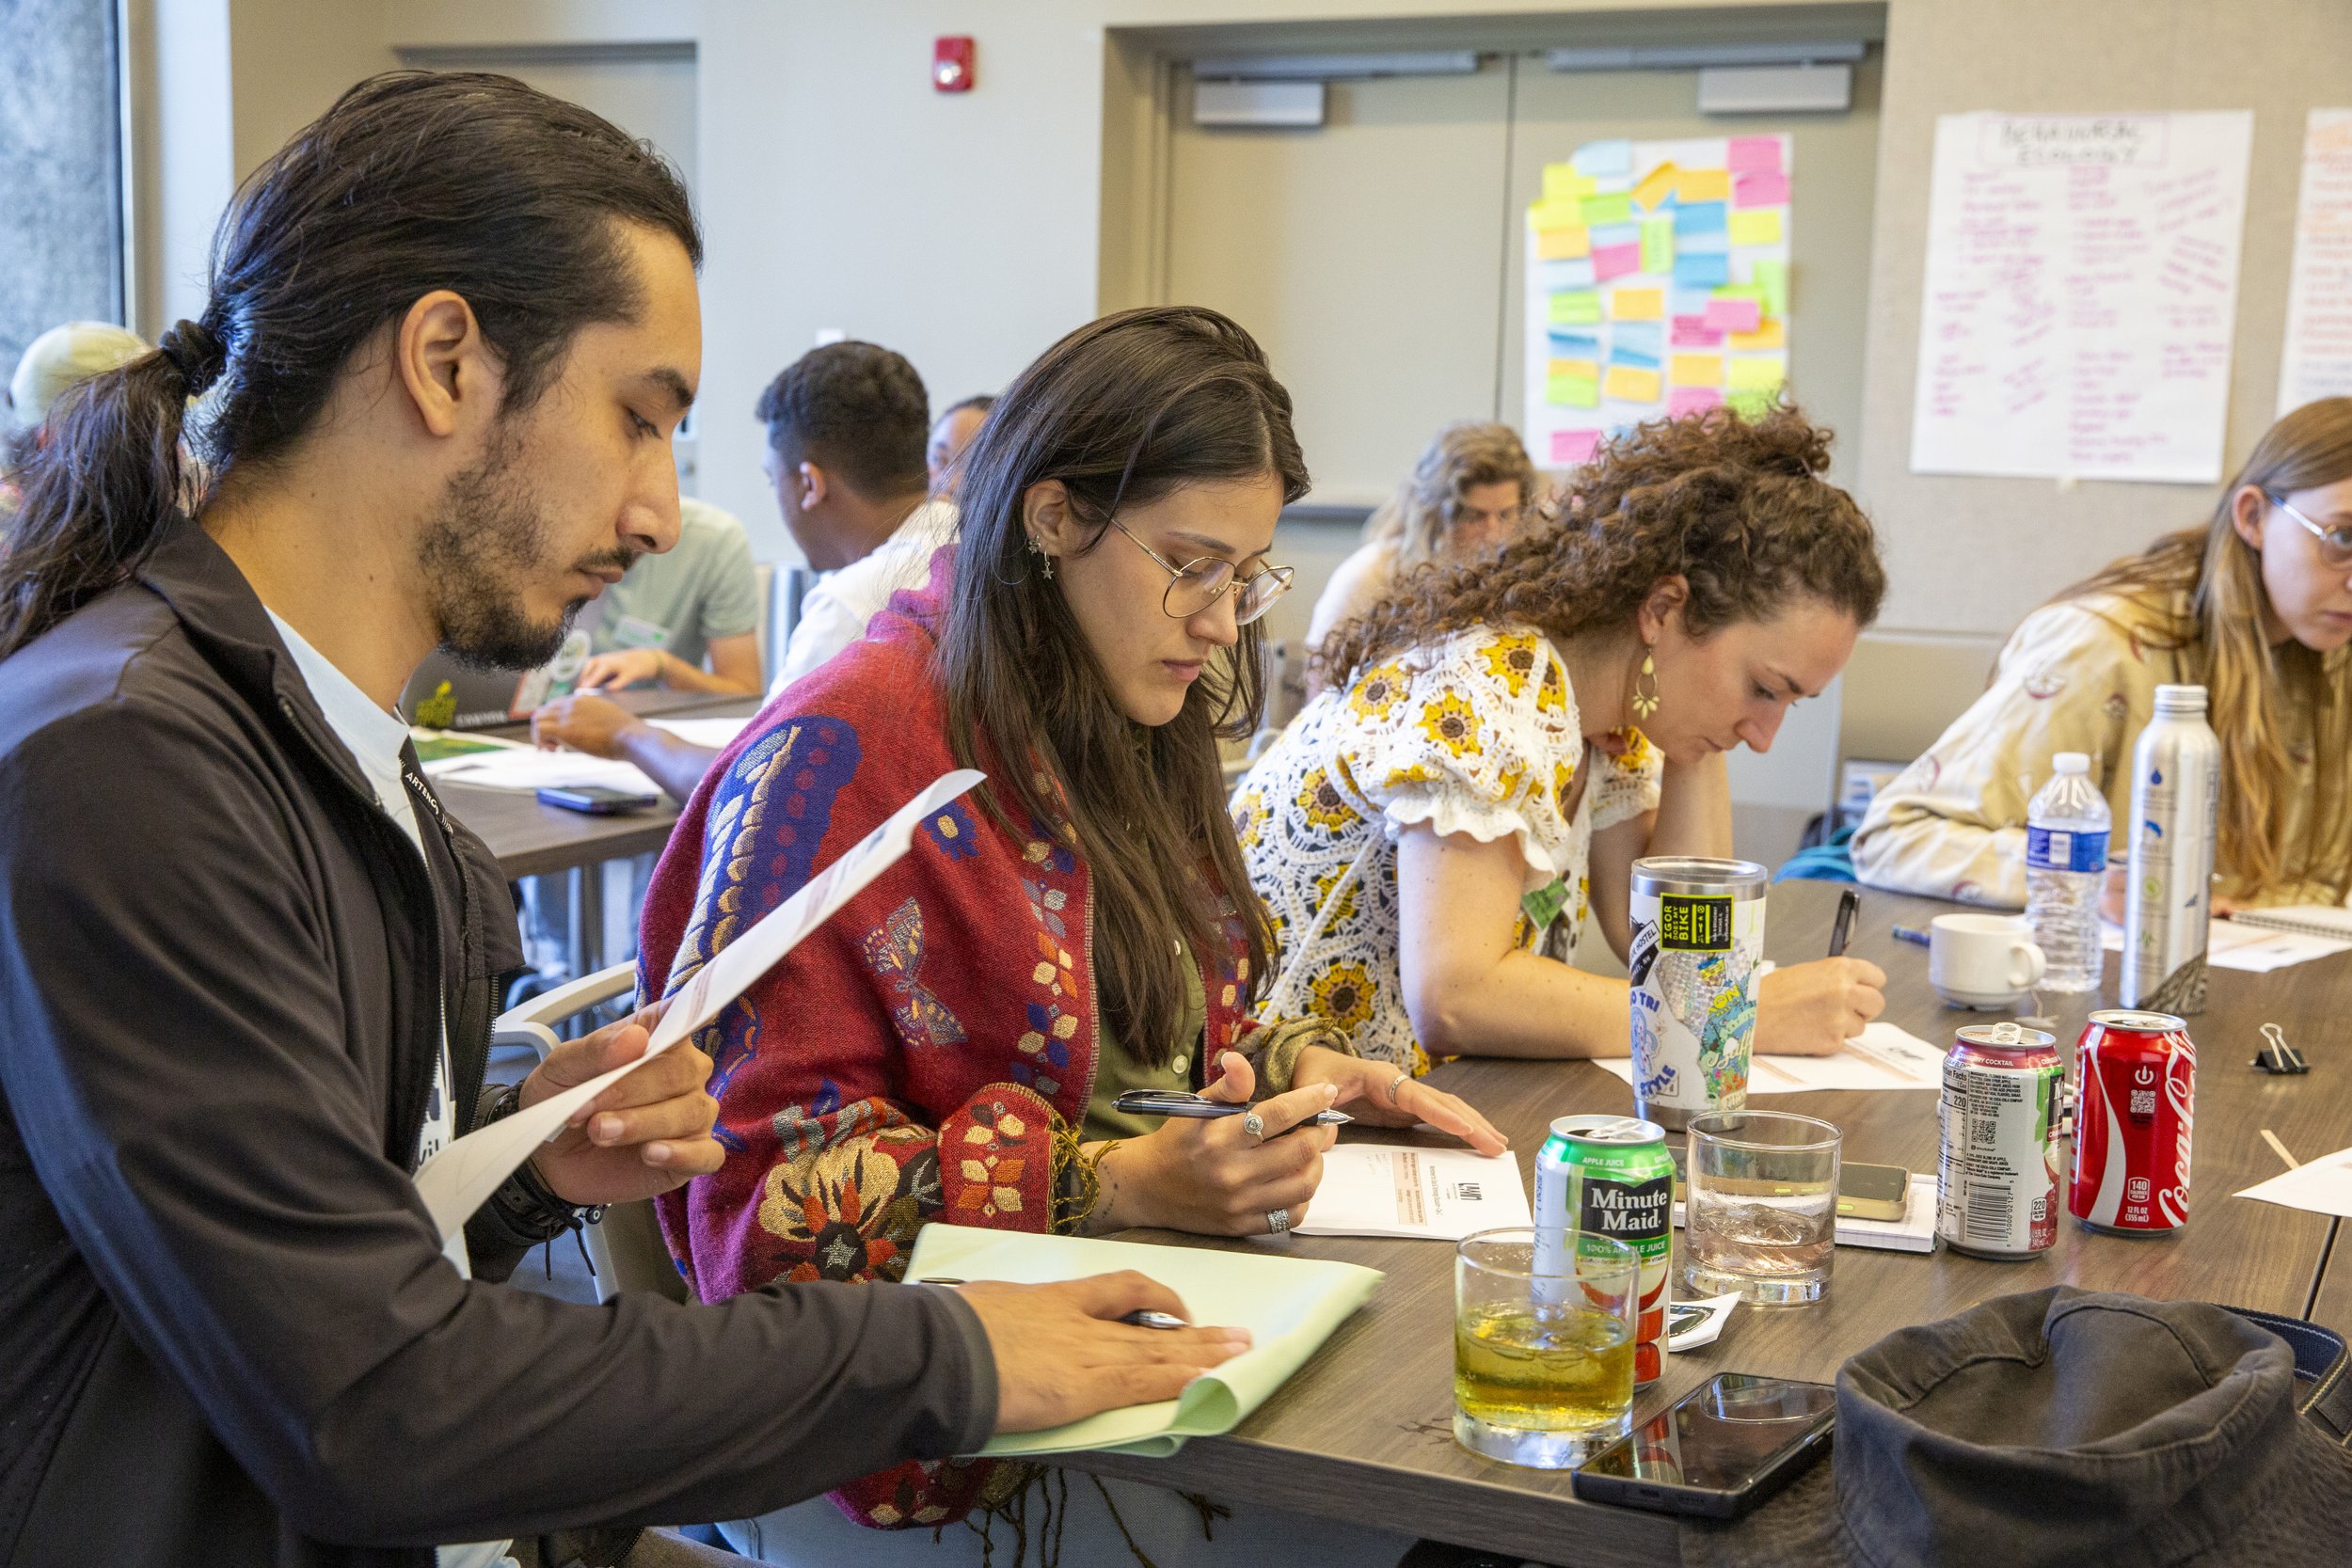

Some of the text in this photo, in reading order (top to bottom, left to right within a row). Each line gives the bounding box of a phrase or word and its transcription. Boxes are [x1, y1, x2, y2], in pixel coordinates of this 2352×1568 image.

[1673, 906, 1678, 919] MY
[1664, 906, 1673, 939] IGOR
[1679, 906, 1689, 940] BIKE
[1637, 928, 1656, 950] HOSTEL
[1639, 992, 1660, 1013] TRI
[1953, 1070, 1967, 1081] Facts
[1954, 1095, 1966, 1108] 220
[2158, 1028, 2198, 1227] Coca-C
[1582, 1157, 1624, 1167] APPLE JUICE
[2131, 1180, 2147, 1190] 140
[1590, 1187, 1668, 1210] Minute
[2034, 1200, 2046, 1210] 220
[1601, 1208, 1660, 1231] Maid
[2125, 1213, 2137, 1222] (355
[1613, 1244, 1645, 1254] APLE
[1647, 1241, 1665, 1252] JUICE
